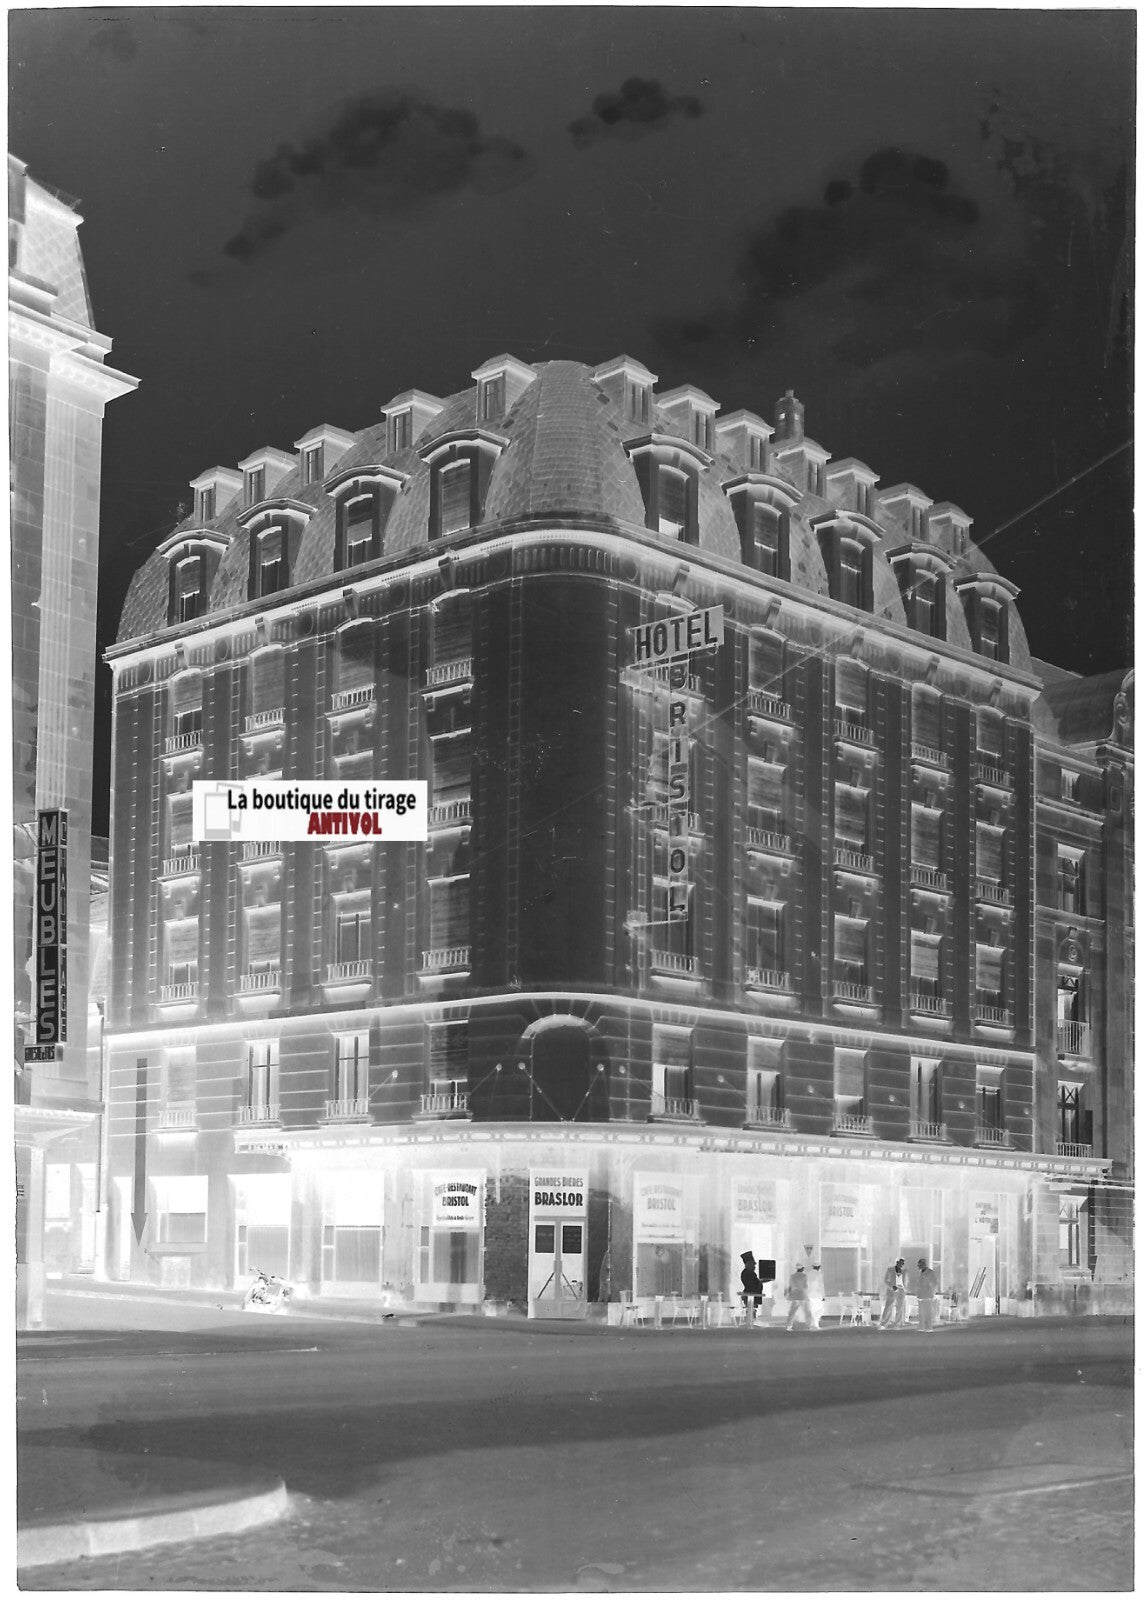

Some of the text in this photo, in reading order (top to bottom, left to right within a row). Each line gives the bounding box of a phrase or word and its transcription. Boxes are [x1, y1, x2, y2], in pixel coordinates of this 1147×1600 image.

[669, 665, 686, 911] BRISTOL
[40, 815, 56, 1040] MEUBLES
[442, 1196, 469, 1207] BRISTOL
[534, 1192, 583, 1206] BRASLOR
